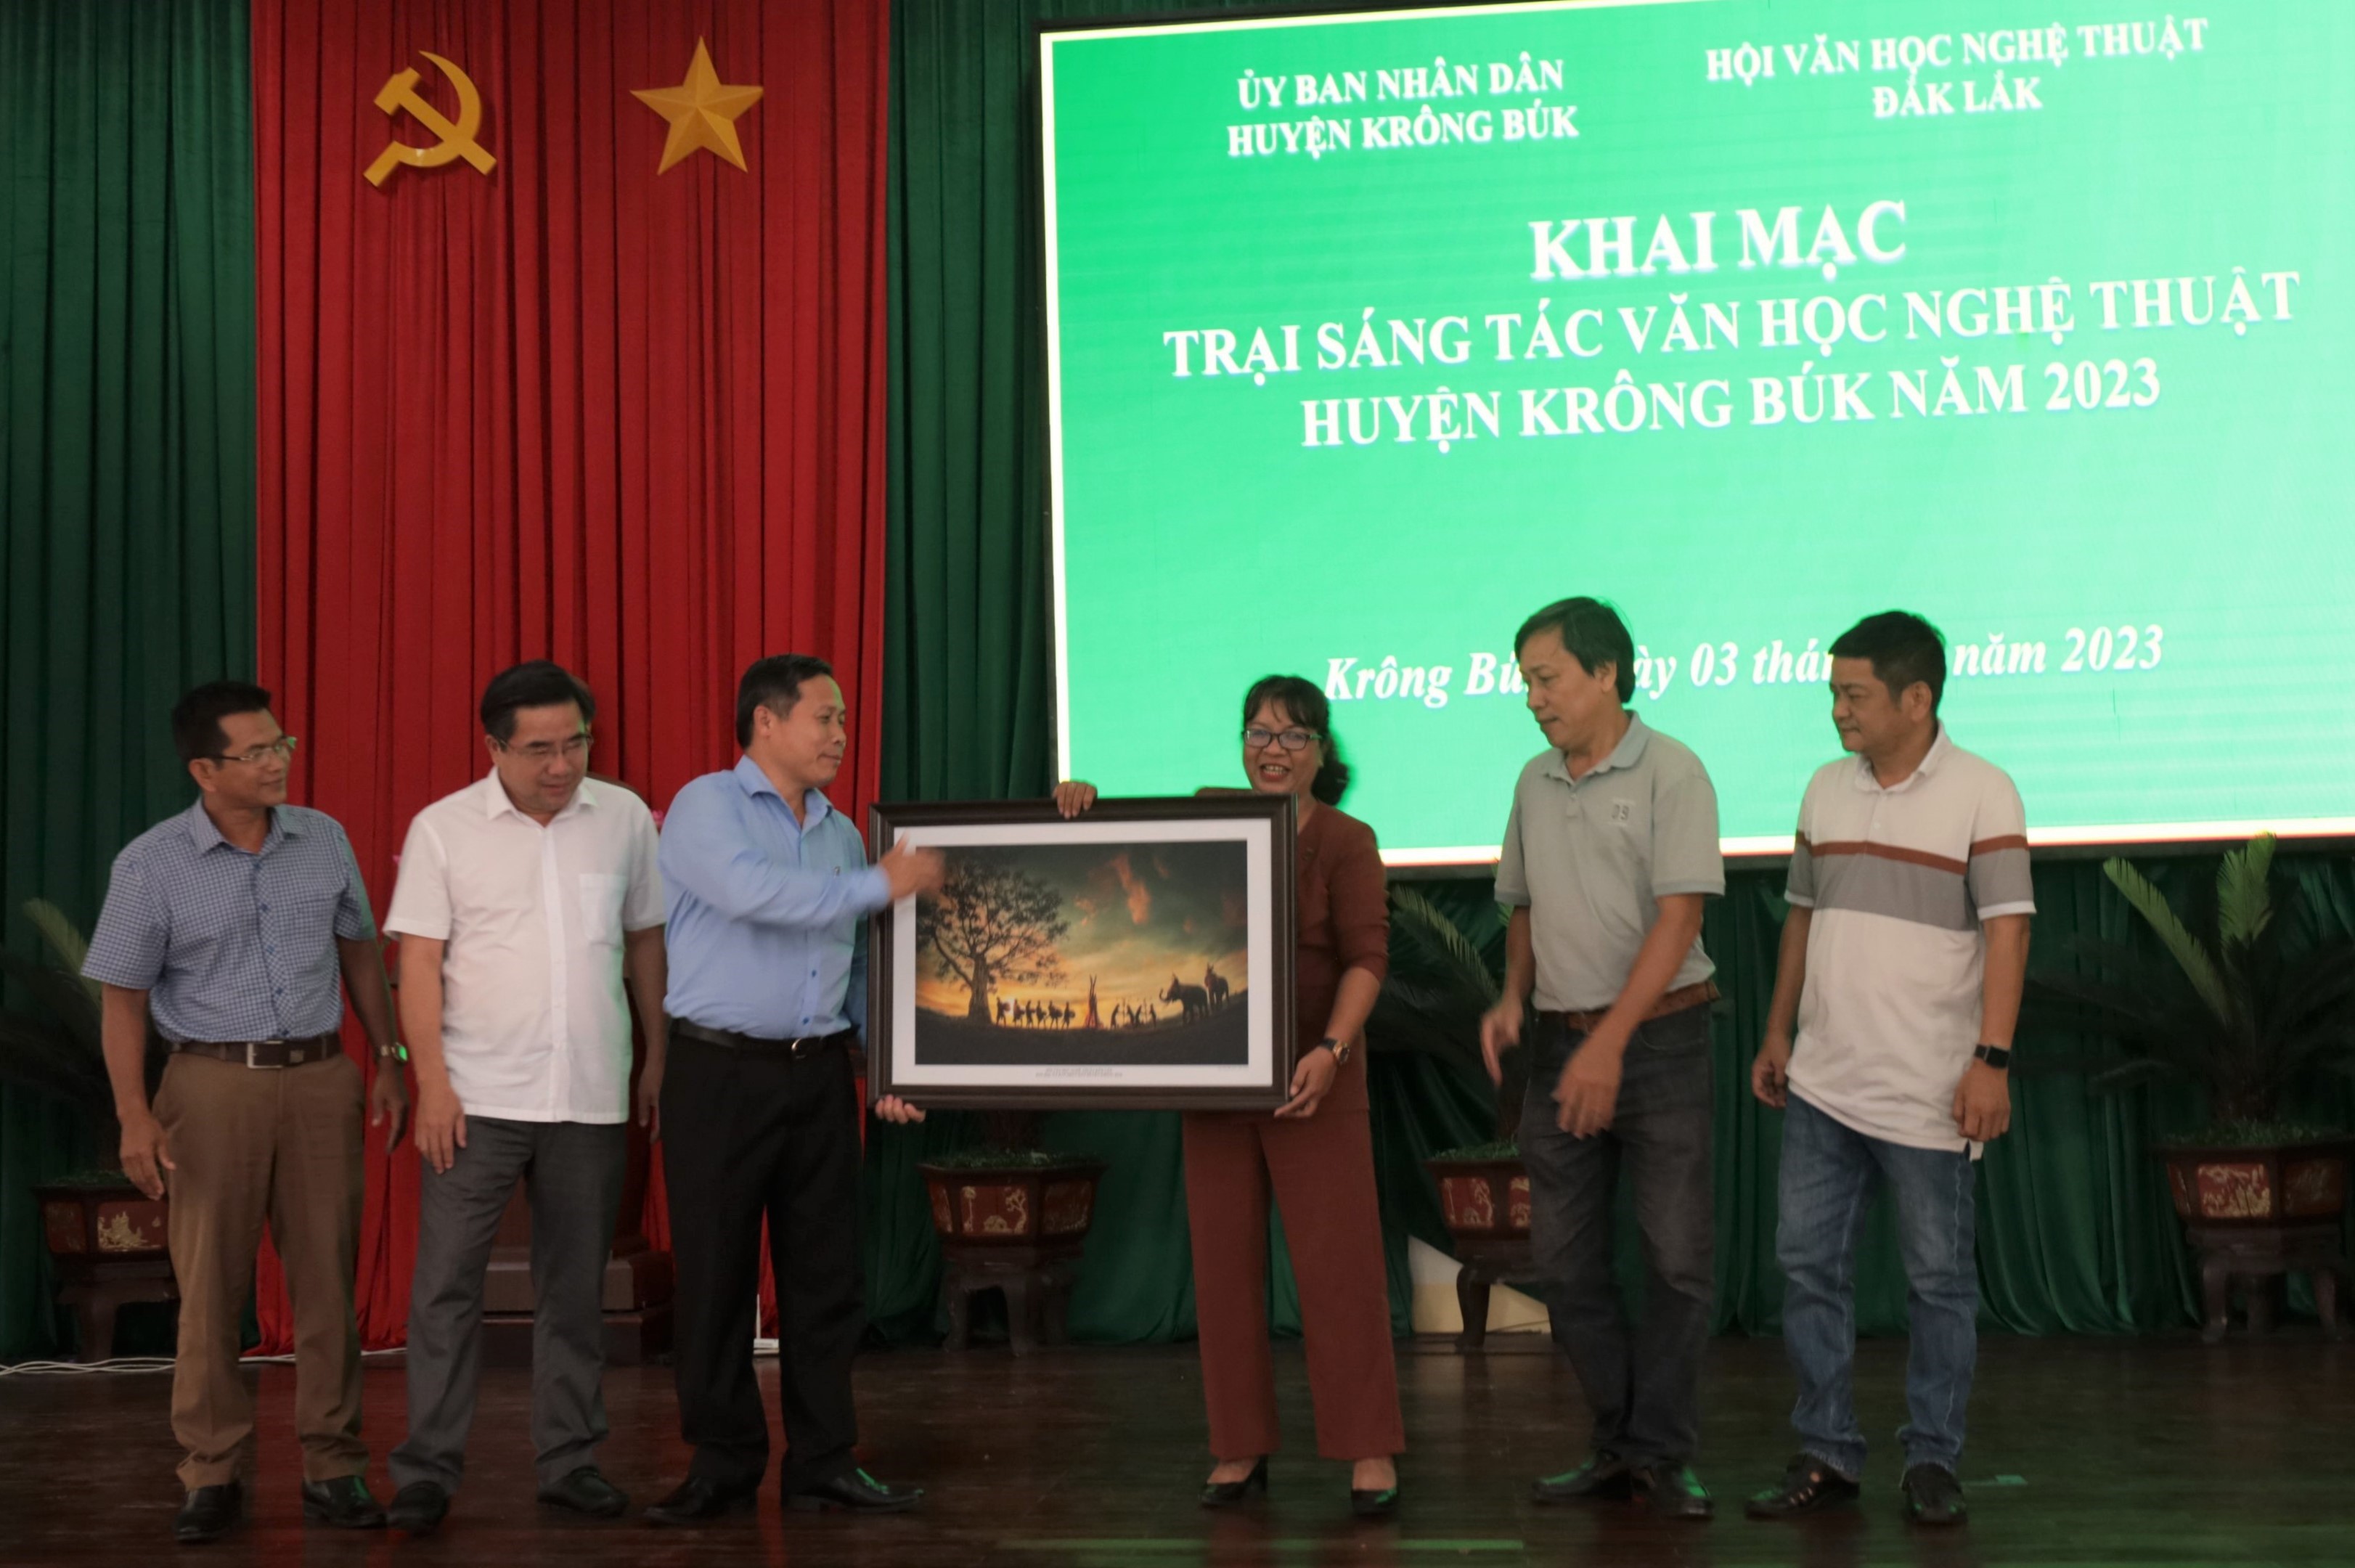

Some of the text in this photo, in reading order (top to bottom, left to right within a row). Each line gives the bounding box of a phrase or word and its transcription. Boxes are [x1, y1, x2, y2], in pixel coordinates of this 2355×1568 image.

[1238, 51, 1563, 110] ỦY BAN NHÂN DÂN
[1706, 15, 2208, 86] HỘI VĂN HỌC NGHỆ THUẬT
[1228, 98, 1579, 160] HUYỆN KRÔNG BÚK
[1528, 200, 1906, 281] KHAI MẠC
[1163, 266, 2300, 386] TRẠI SÁNG TÁC VĂN HỌC NGHỆ THUẬT
[1302, 356, 2160, 454] HUYỆN KRÔNG BÚK NĂM 2023
[1324, 655, 1453, 709] Krông
[1464, 650, 1529, 695] Bú
[1690, 642, 1739, 687] 03
[1953, 633, 2046, 676] năm
[2061, 624, 2163, 671] 2023
